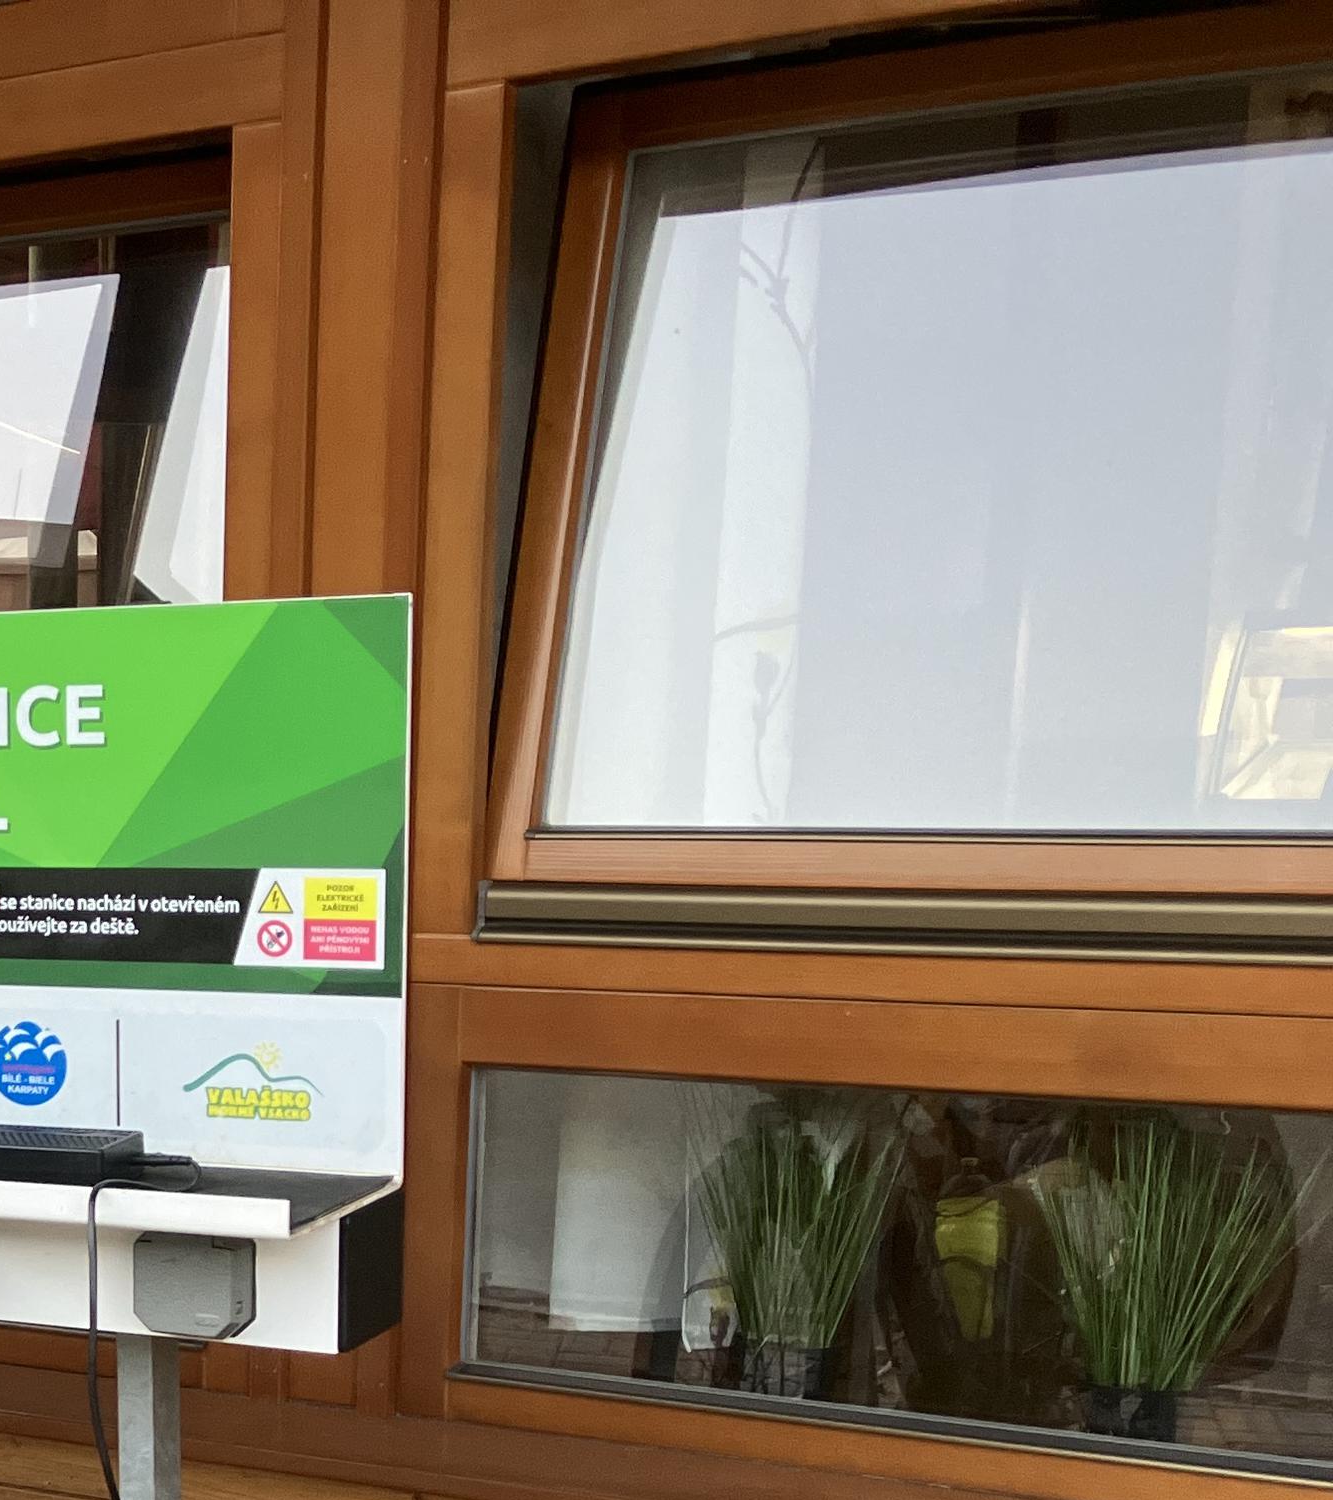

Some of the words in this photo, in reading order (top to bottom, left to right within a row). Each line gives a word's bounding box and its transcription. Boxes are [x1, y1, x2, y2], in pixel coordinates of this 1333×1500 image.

[0, 897, 17, 911] se
[19, 894, 74, 911] stanice
[77, 894, 135, 913] nachází
[138, 900, 148, 912] v
[151, 895, 240, 914] otevřeném
[70, 921, 88, 934] za
[90, 918, 139, 936] deště.
[206, 1085, 312, 1109] VALAŠSKO
